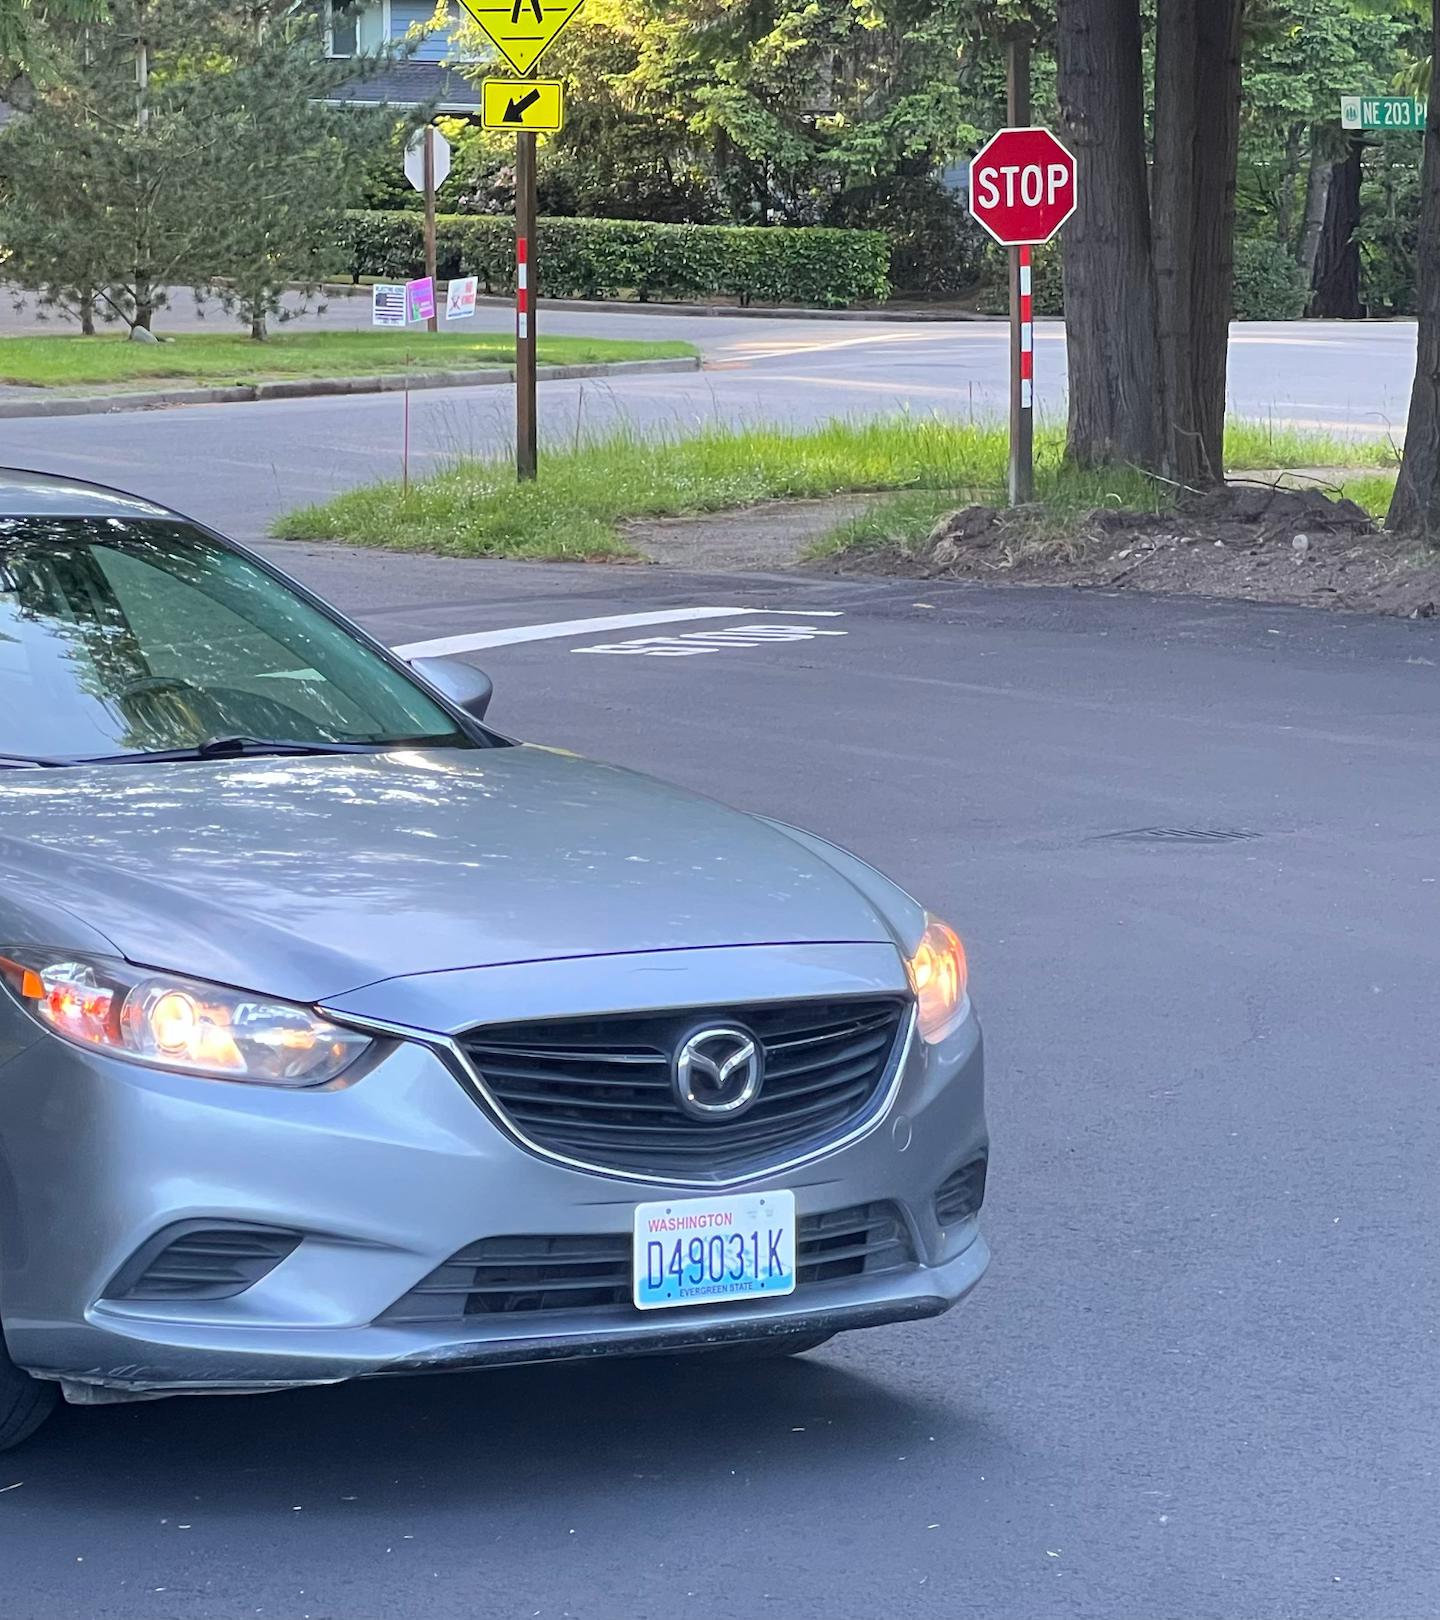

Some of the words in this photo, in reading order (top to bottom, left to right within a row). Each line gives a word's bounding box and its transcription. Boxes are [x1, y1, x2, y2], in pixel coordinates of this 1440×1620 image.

[1363, 102, 1380, 124] NE
[1384, 102, 1410, 125] 203
[978, 164, 1069, 209] STOP
[570, 625, 848, 656] STOP
[648, 1213, 732, 1232] WASHINGTON
[648, 1228, 783, 1290] D49031K
[680, 1284, 728, 1297] EVERGREEN
[730, 1282, 753, 1293] STATE
